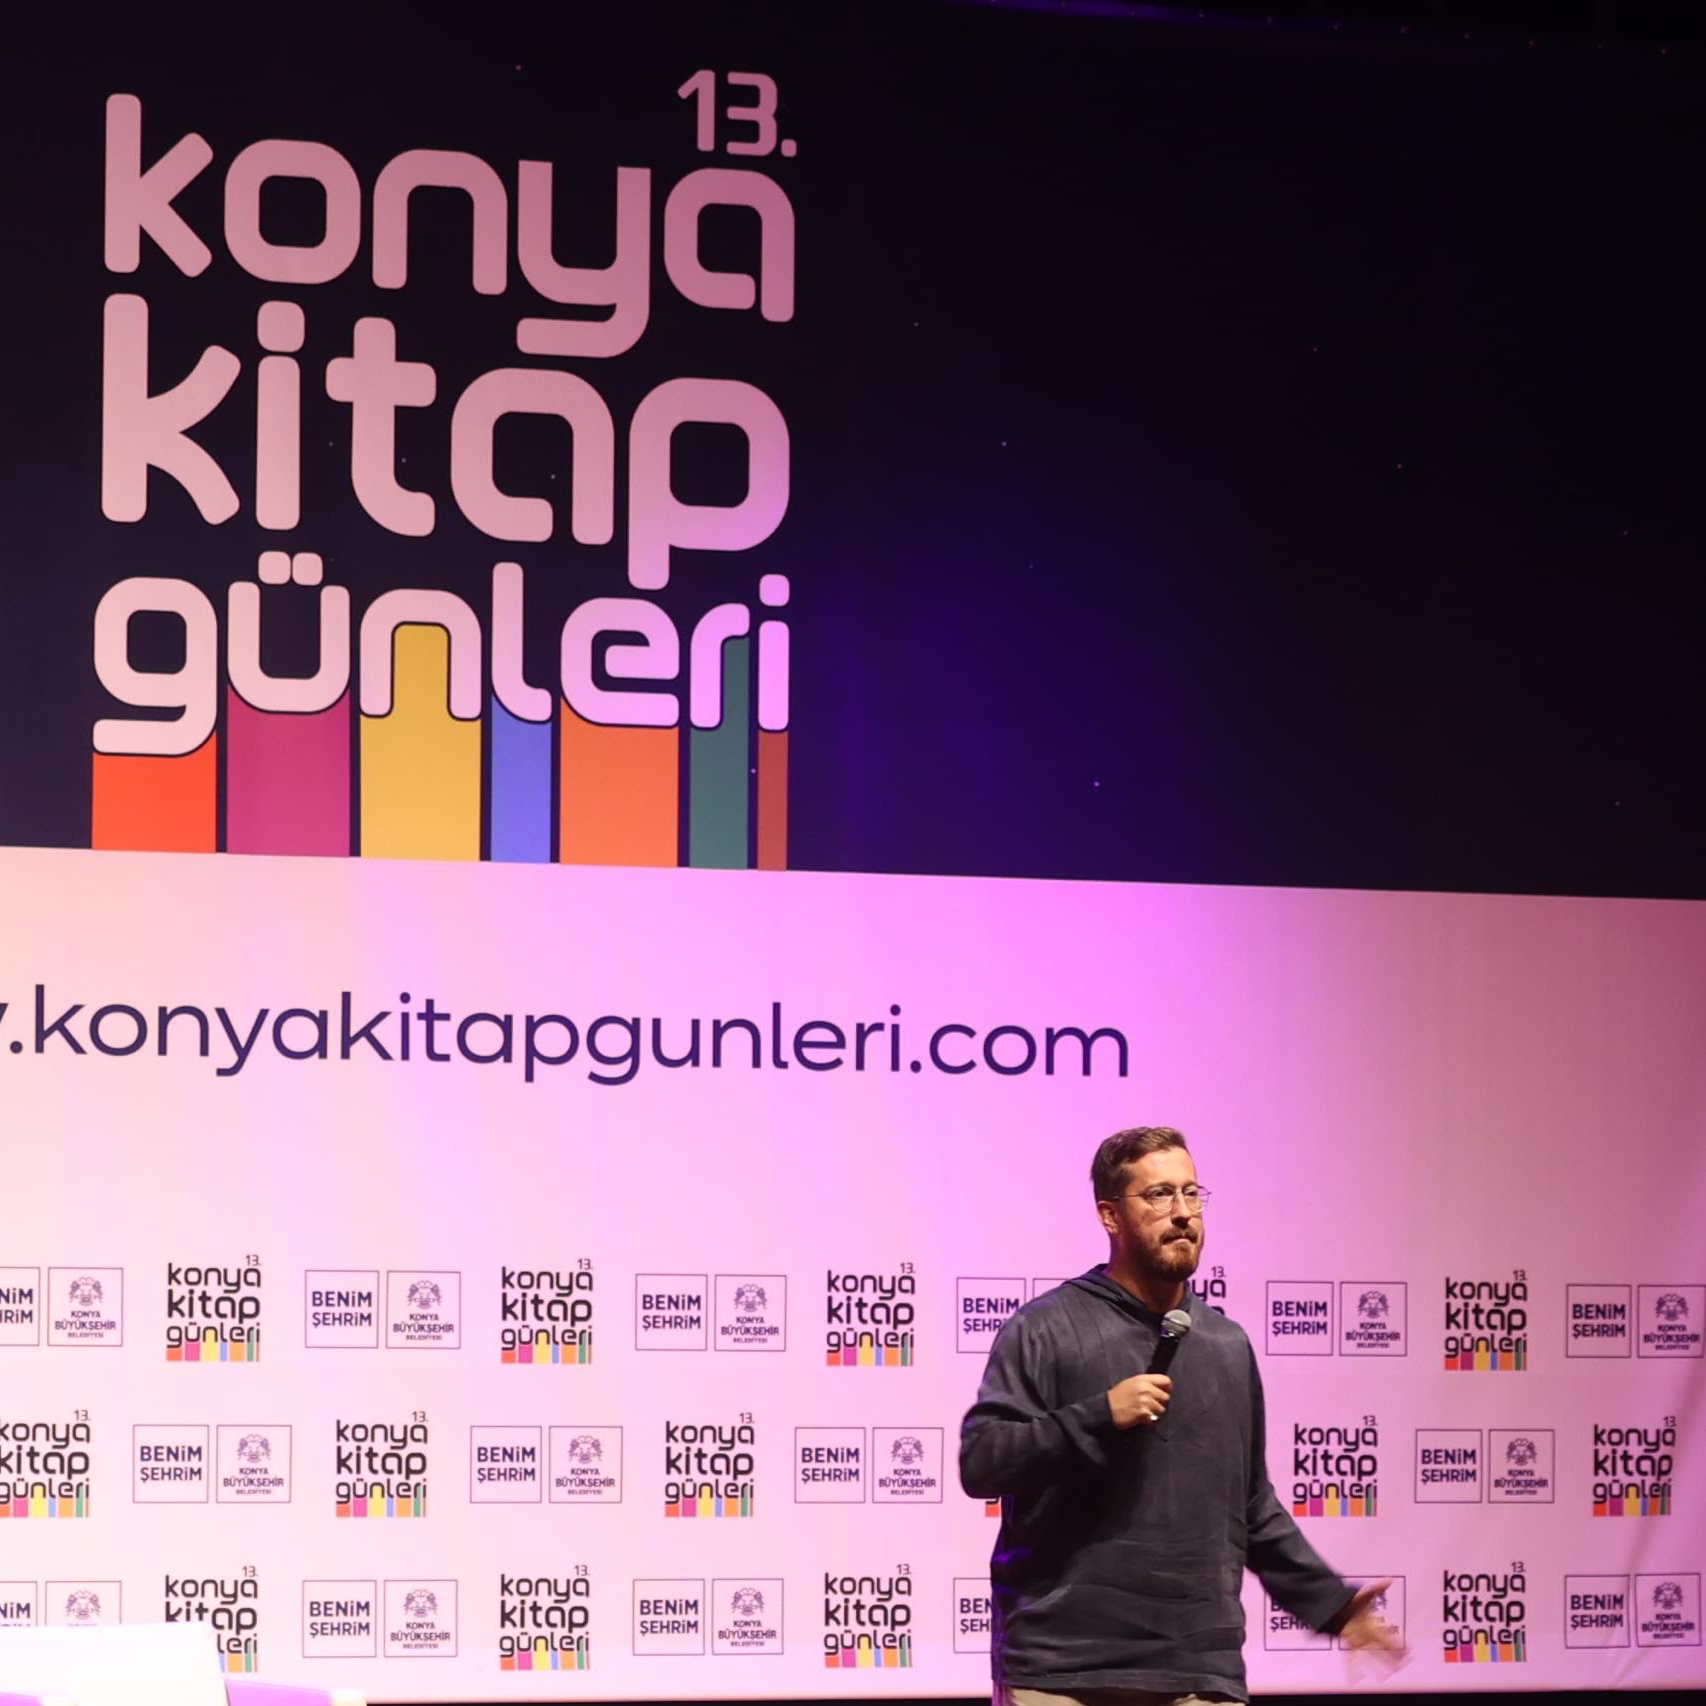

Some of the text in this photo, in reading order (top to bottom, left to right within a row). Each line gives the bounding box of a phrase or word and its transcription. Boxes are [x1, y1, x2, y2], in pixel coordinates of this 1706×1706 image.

[677, 70, 798, 157] 13.
[104, 93, 796, 359] konya
[101, 292, 791, 590] kitap
[92, 550, 790, 757] günleri
[167, 1262, 261, 1294] konya
[827, 1270, 915, 1301] konya
[1445, 1277, 1528, 1307] konya
[69, 1309, 100, 1318] KONYA
[167, 1289, 261, 1325] kitap
[735, 1315, 766, 1324] KONYA
[827, 1295, 915, 1331] kitap
[1445, 1302, 1528, 1336] kitap
[166, 1322, 261, 1350] günleri
[826, 1327, 915, 1355] günleri
[1444, 1333, 1528, 1360] günleri
[337, 1419, 428, 1451] konya
[1294, 1423, 1377, 1453] konya
[1593, 1424, 1677, 1454] konya
[238, 1466, 270, 1475] KONYA
[337, 1445, 428, 1481] kitap
[1294, 1448, 1377, 1482] kitap
[1593, 1448, 1673, 1483] kitap
[336, 1477, 428, 1505] günleri
[1293, 1479, 1377, 1506] günleri
[1592, 1479, 1673, 1506] günleri
[500, 1573, 590, 1604] konya
[1445, 1570, 1527, 1599] konya
[500, 1599, 590, 1634] kitap
[733, 1620, 763, 1628] KONYA
[1444, 1594, 1527, 1628] kitap
[499, 1631, 590, 1658] günleri
[1444, 1625, 1527, 1651] günleri
